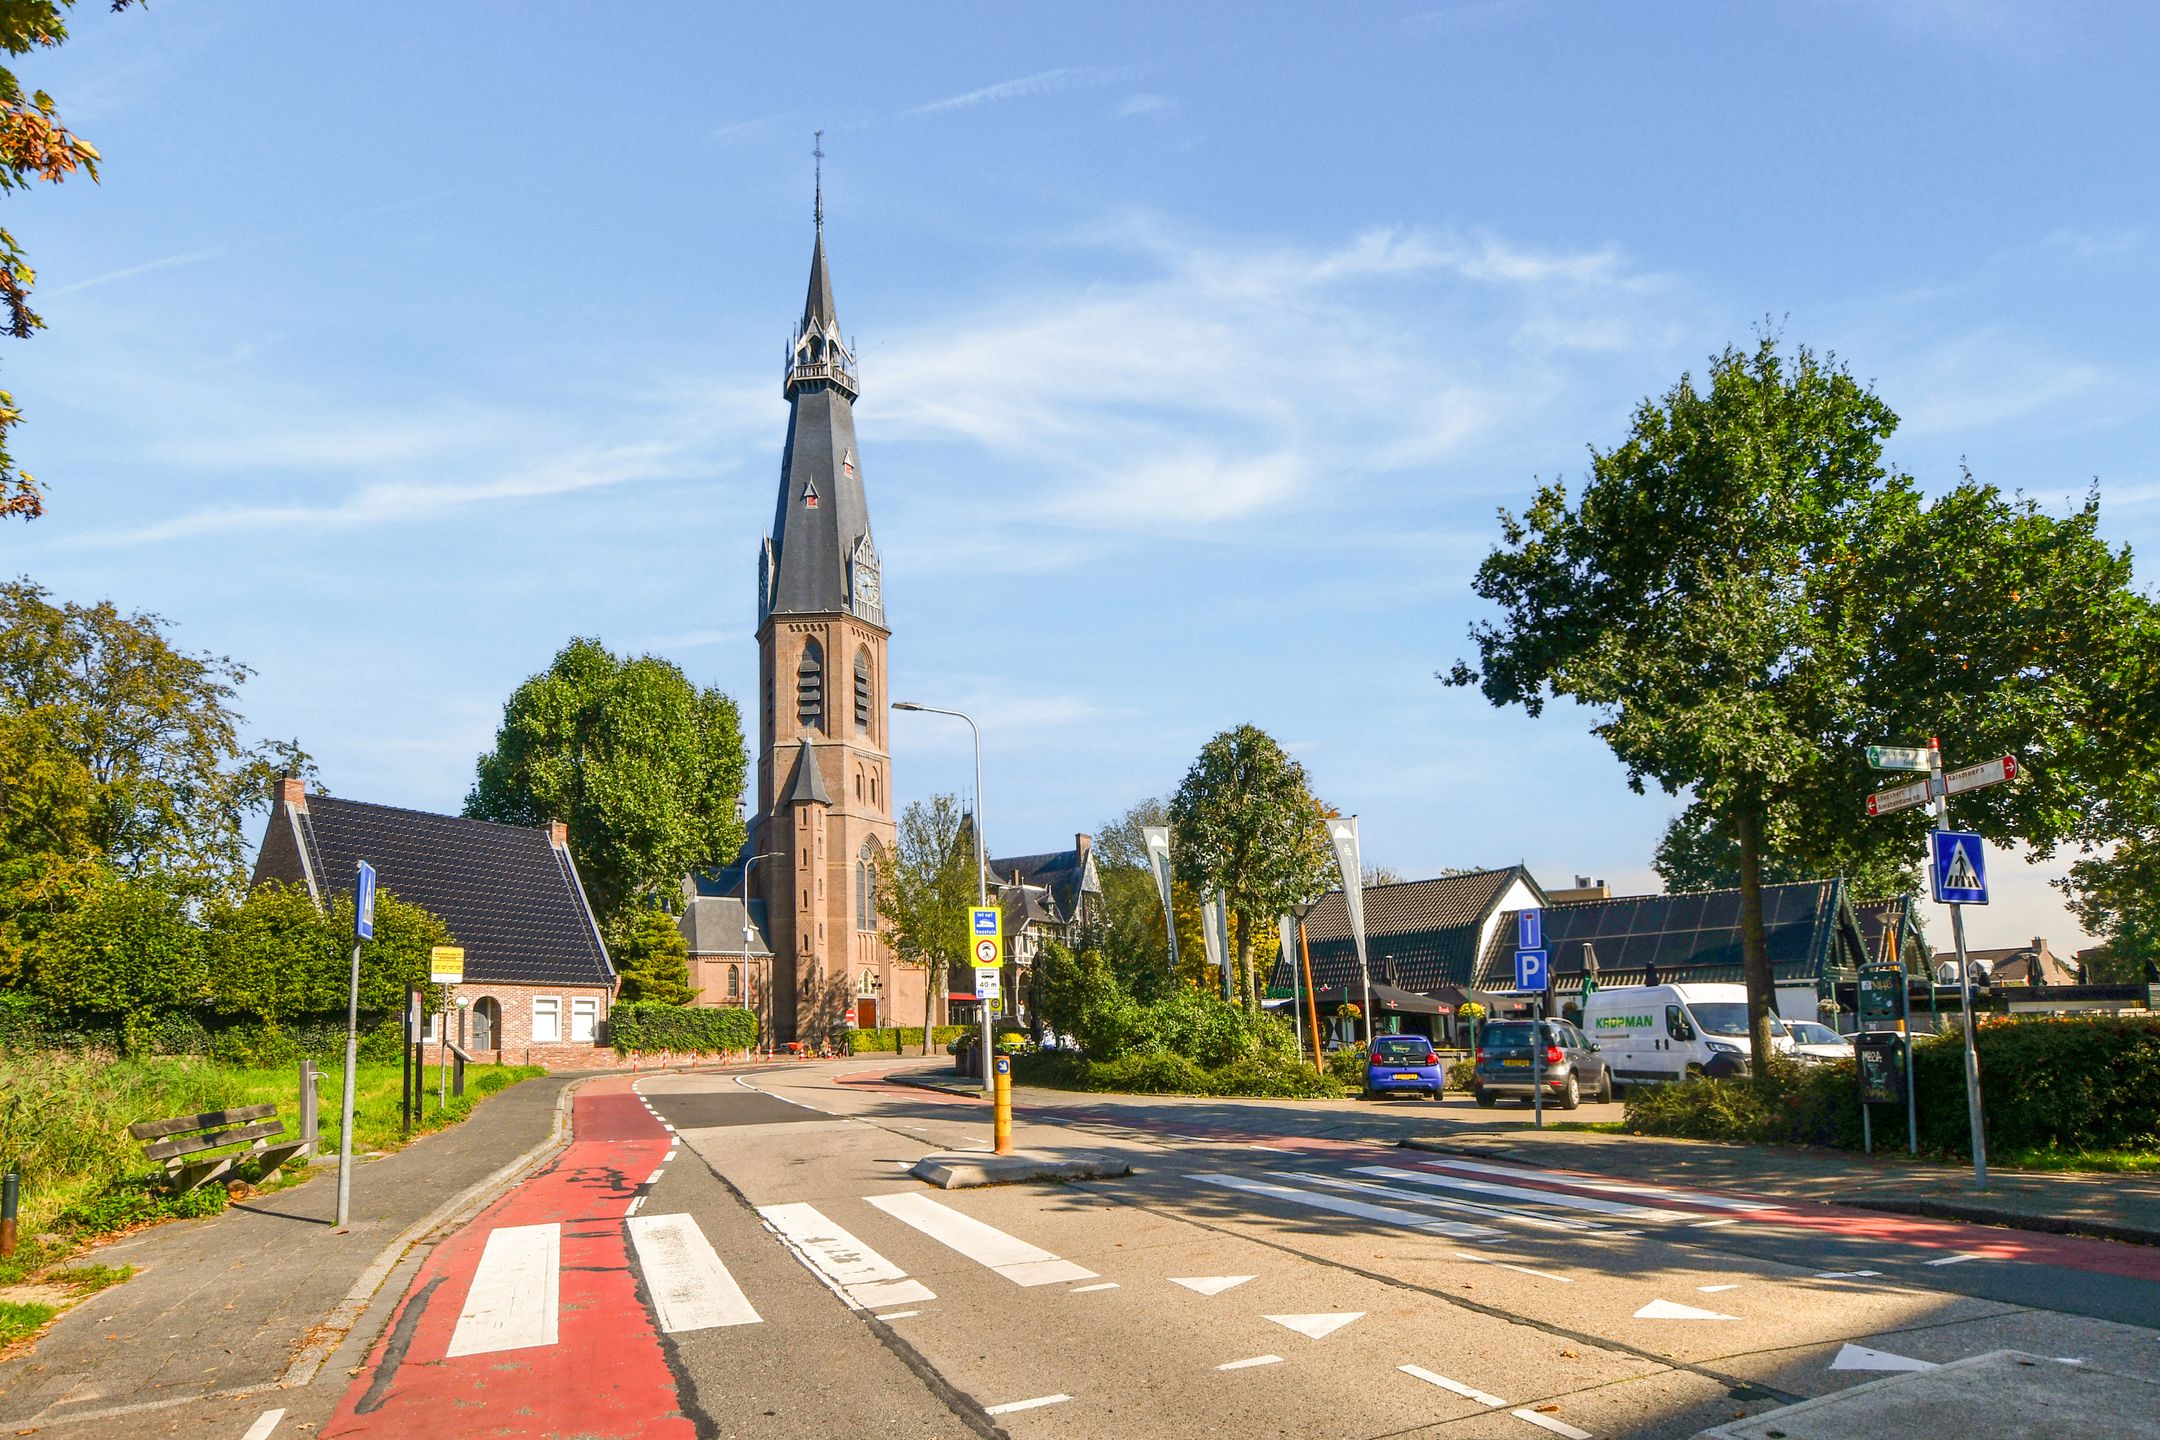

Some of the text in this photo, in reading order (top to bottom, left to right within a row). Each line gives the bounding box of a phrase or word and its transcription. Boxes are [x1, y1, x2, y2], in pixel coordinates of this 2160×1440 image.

[1948, 768, 1980, 781] Aalsmeer
[1878, 796, 1912, 810] Amsterdam
[1522, 955, 1539, 986] P
[1596, 1015, 1653, 1029] KROPMAN
